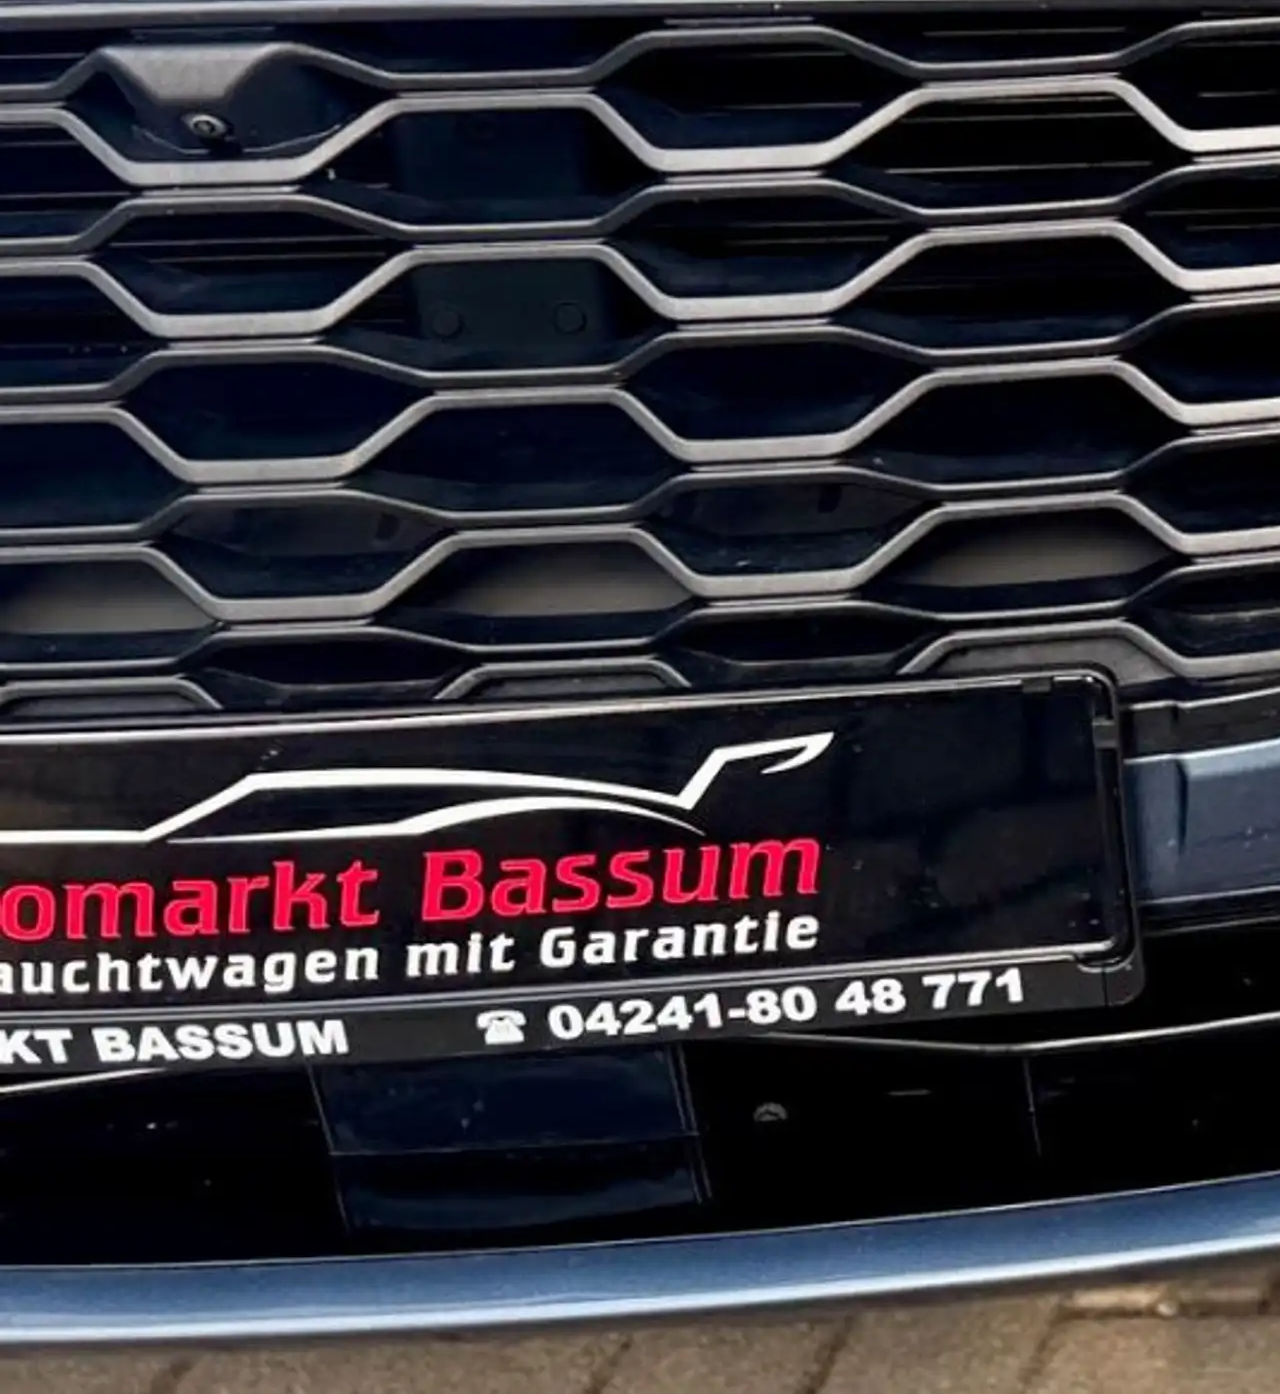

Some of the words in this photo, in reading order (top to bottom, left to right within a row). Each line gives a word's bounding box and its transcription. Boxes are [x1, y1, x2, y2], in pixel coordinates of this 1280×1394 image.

[0, 861, 378, 941] omarkt
[422, 839, 819, 921] Bassum
[406, 933, 514, 977] mit
[540, 911, 820, 969] Garantie
[91, 1018, 348, 1063] BASSUM
[548, 993, 817, 1040] 04241-80
[835, 979, 906, 1016] 48
[922, 966, 1024, 1010] 771
